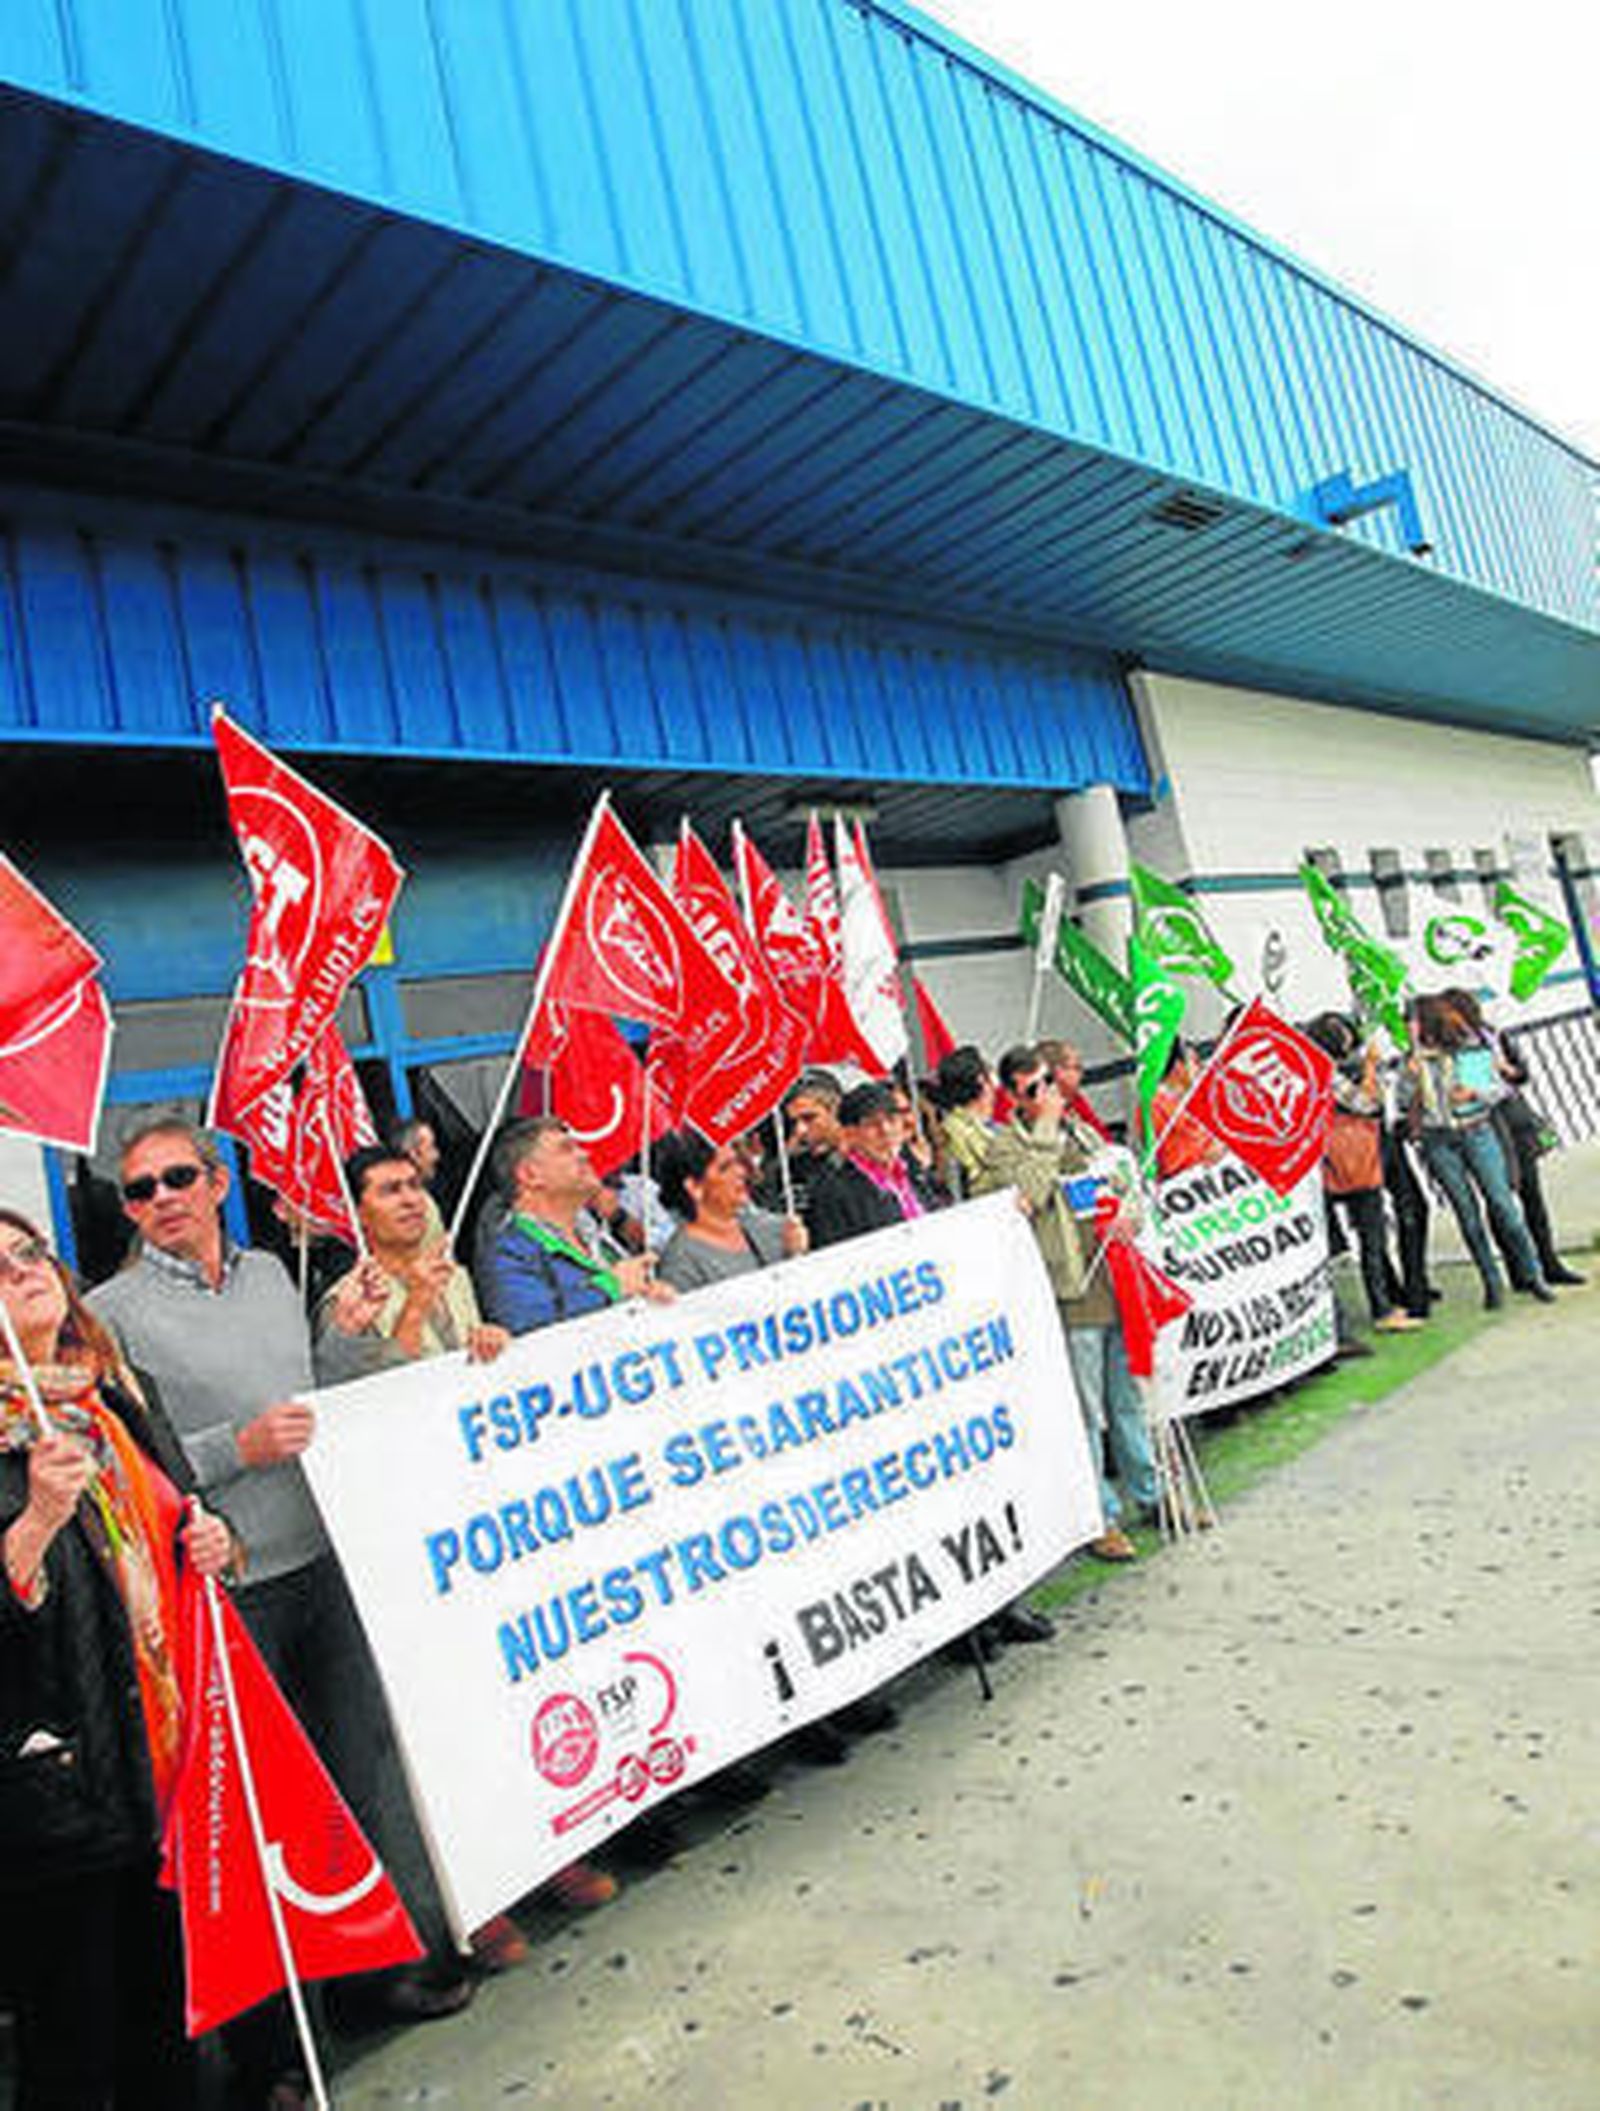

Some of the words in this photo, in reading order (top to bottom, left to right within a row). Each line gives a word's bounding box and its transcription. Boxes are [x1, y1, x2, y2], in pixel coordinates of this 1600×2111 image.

[458, 1339, 684, 1463] FSP-UGT
[692, 1259, 948, 1382] PRISIONES
[424, 1452, 654, 1595] PORQUE
[796, 1552, 943, 1669] BASTA
